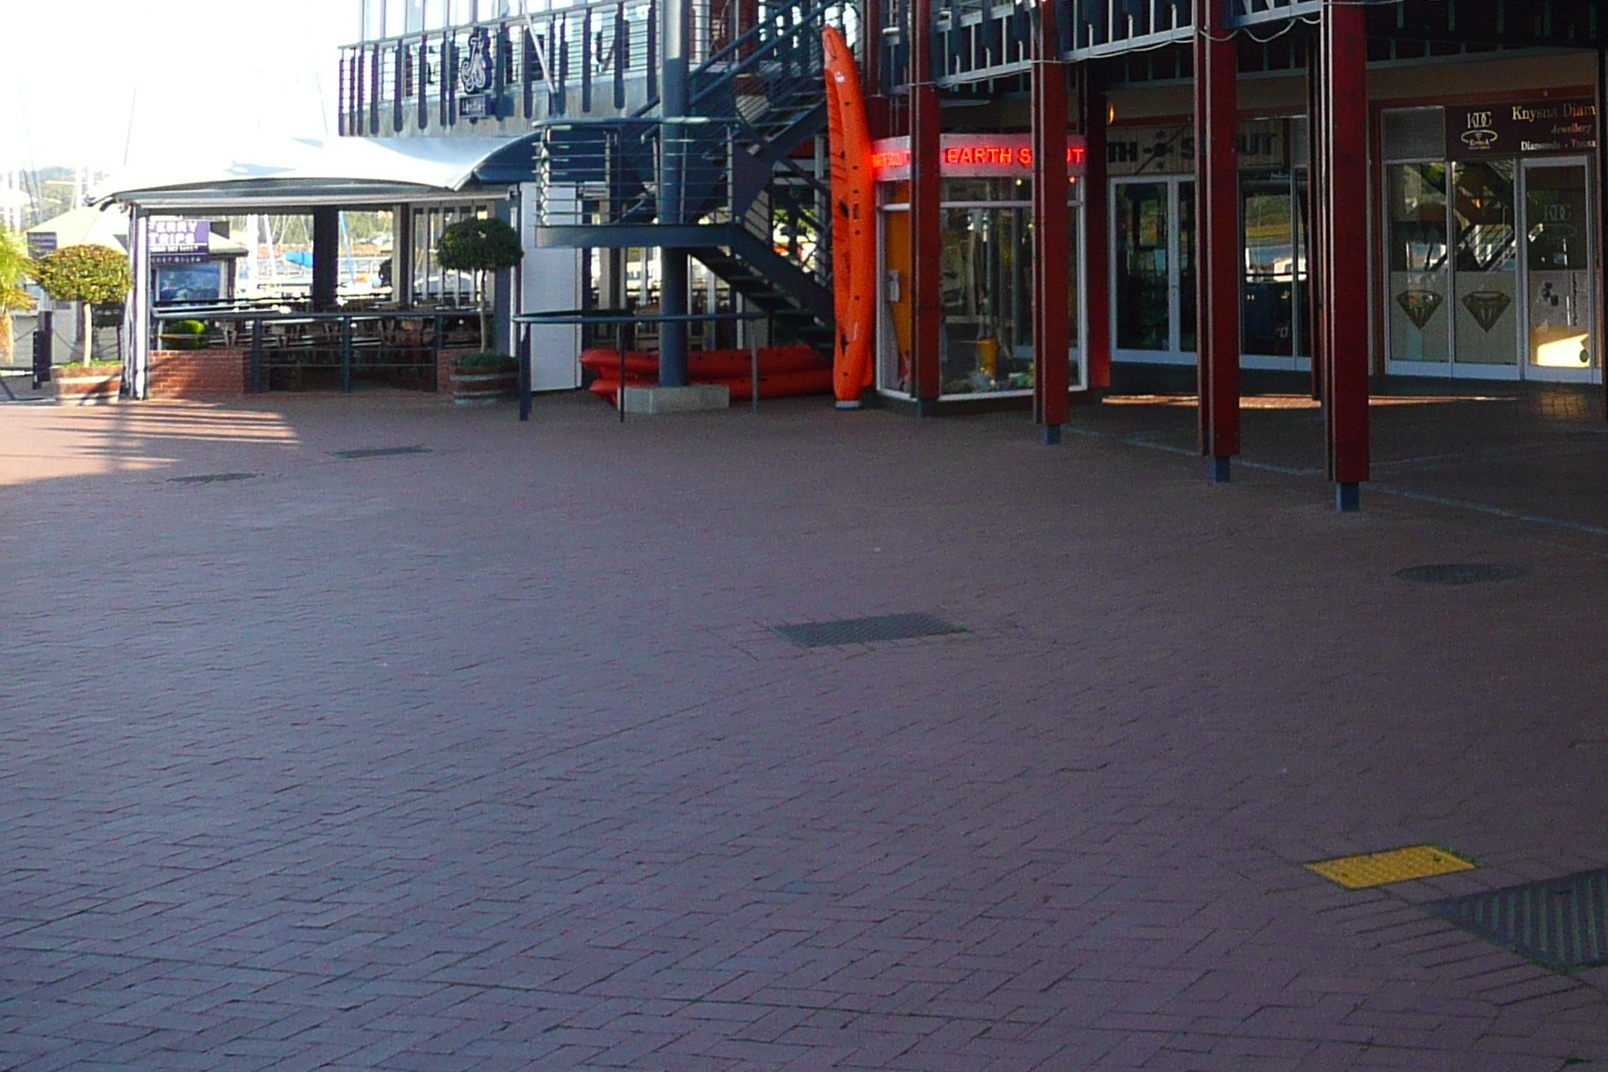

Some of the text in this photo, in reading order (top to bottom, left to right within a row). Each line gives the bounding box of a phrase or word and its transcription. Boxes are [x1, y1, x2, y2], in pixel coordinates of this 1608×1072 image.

[1512, 105, 1559, 122] Knysna
[1551, 122, 1593, 134] Jewellery
[946, 147, 1012, 164] EARTH
